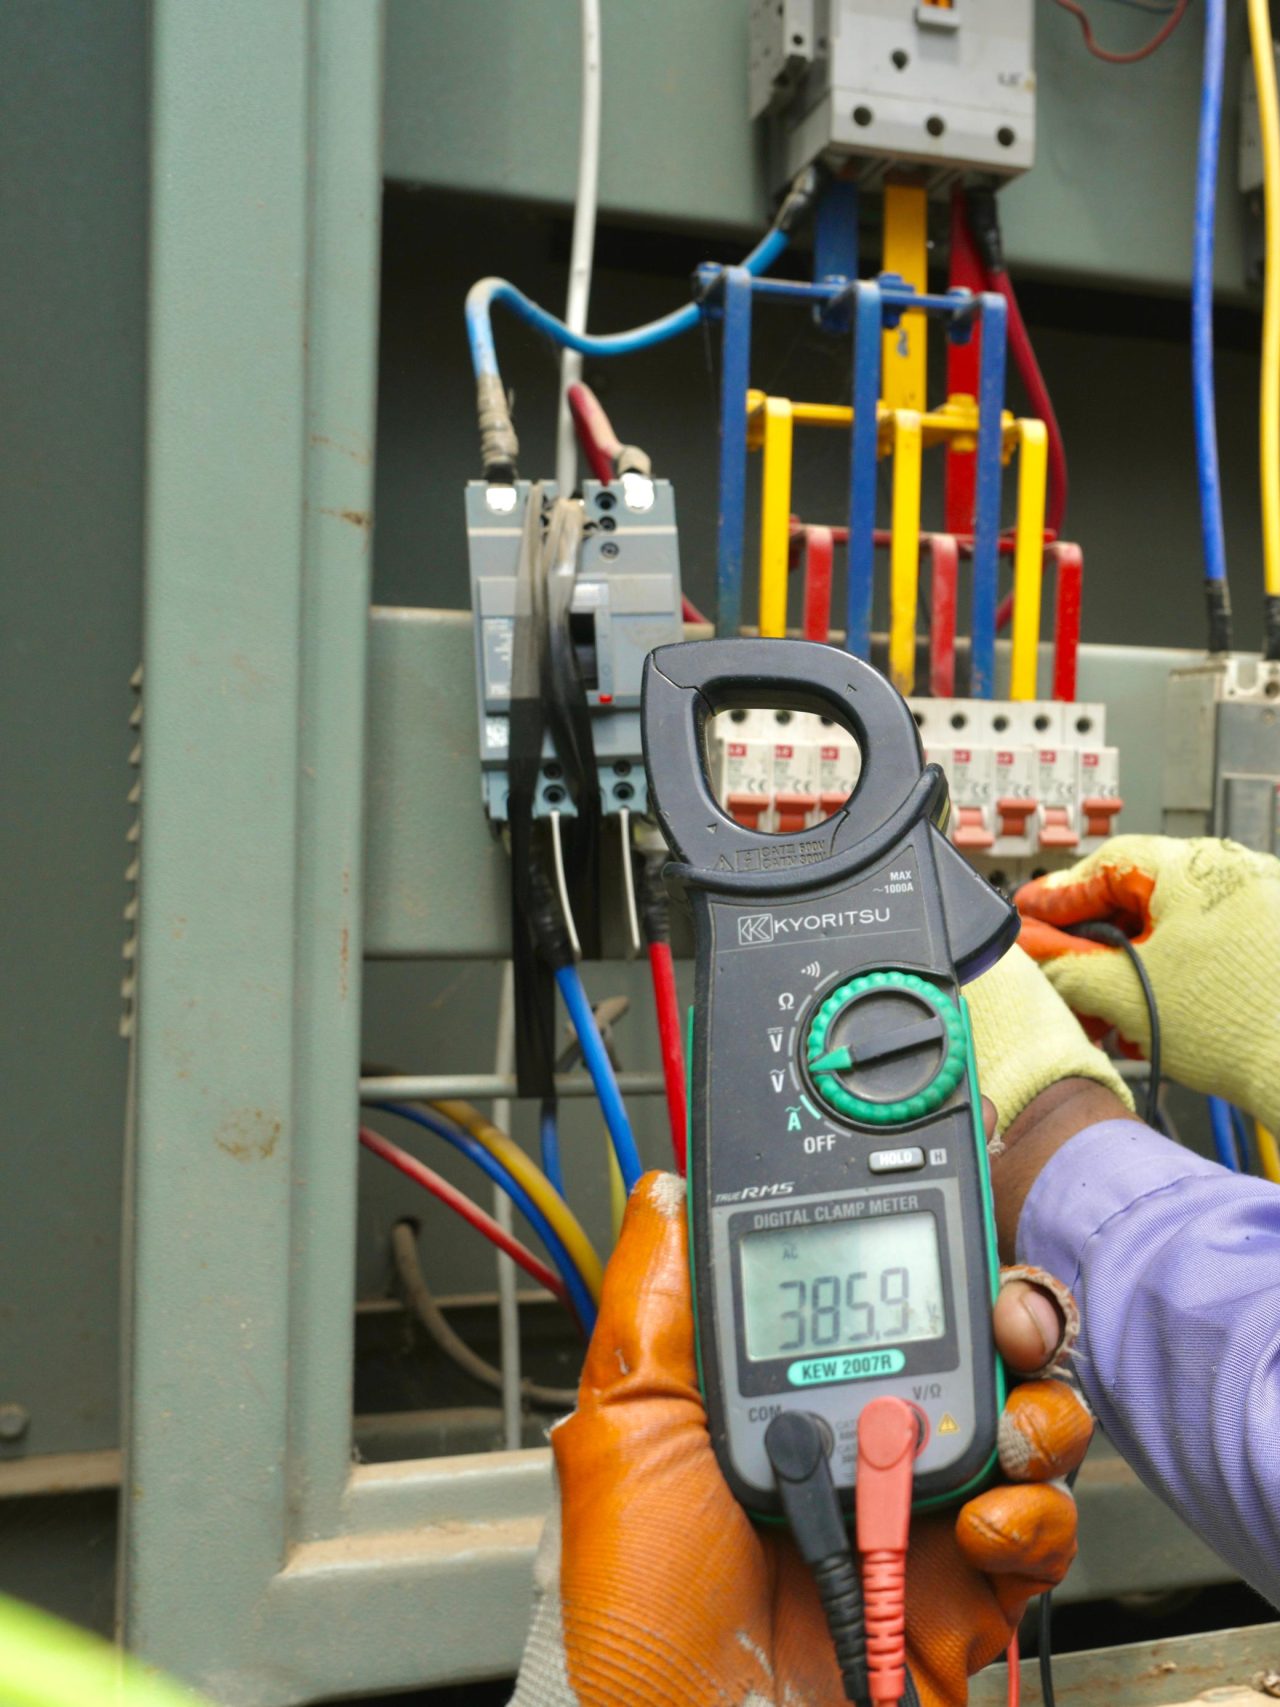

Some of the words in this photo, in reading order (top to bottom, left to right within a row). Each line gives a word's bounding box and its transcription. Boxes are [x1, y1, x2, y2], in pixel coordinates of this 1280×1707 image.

[890, 870, 912, 881] MAX
[774, 907, 891, 934] KYORITSU
[804, 1134, 837, 1154] OFF
[879, 1151, 913, 1166] HOLD
[934, 1152, 943, 1162] H
[754, 1210, 811, 1230] DIGITAL
[814, 1202, 866, 1222] CLAMP
[870, 1195, 919, 1214] METER
[802, 1360, 838, 1380] KEW
[842, 1354, 893, 1376] 2007R
